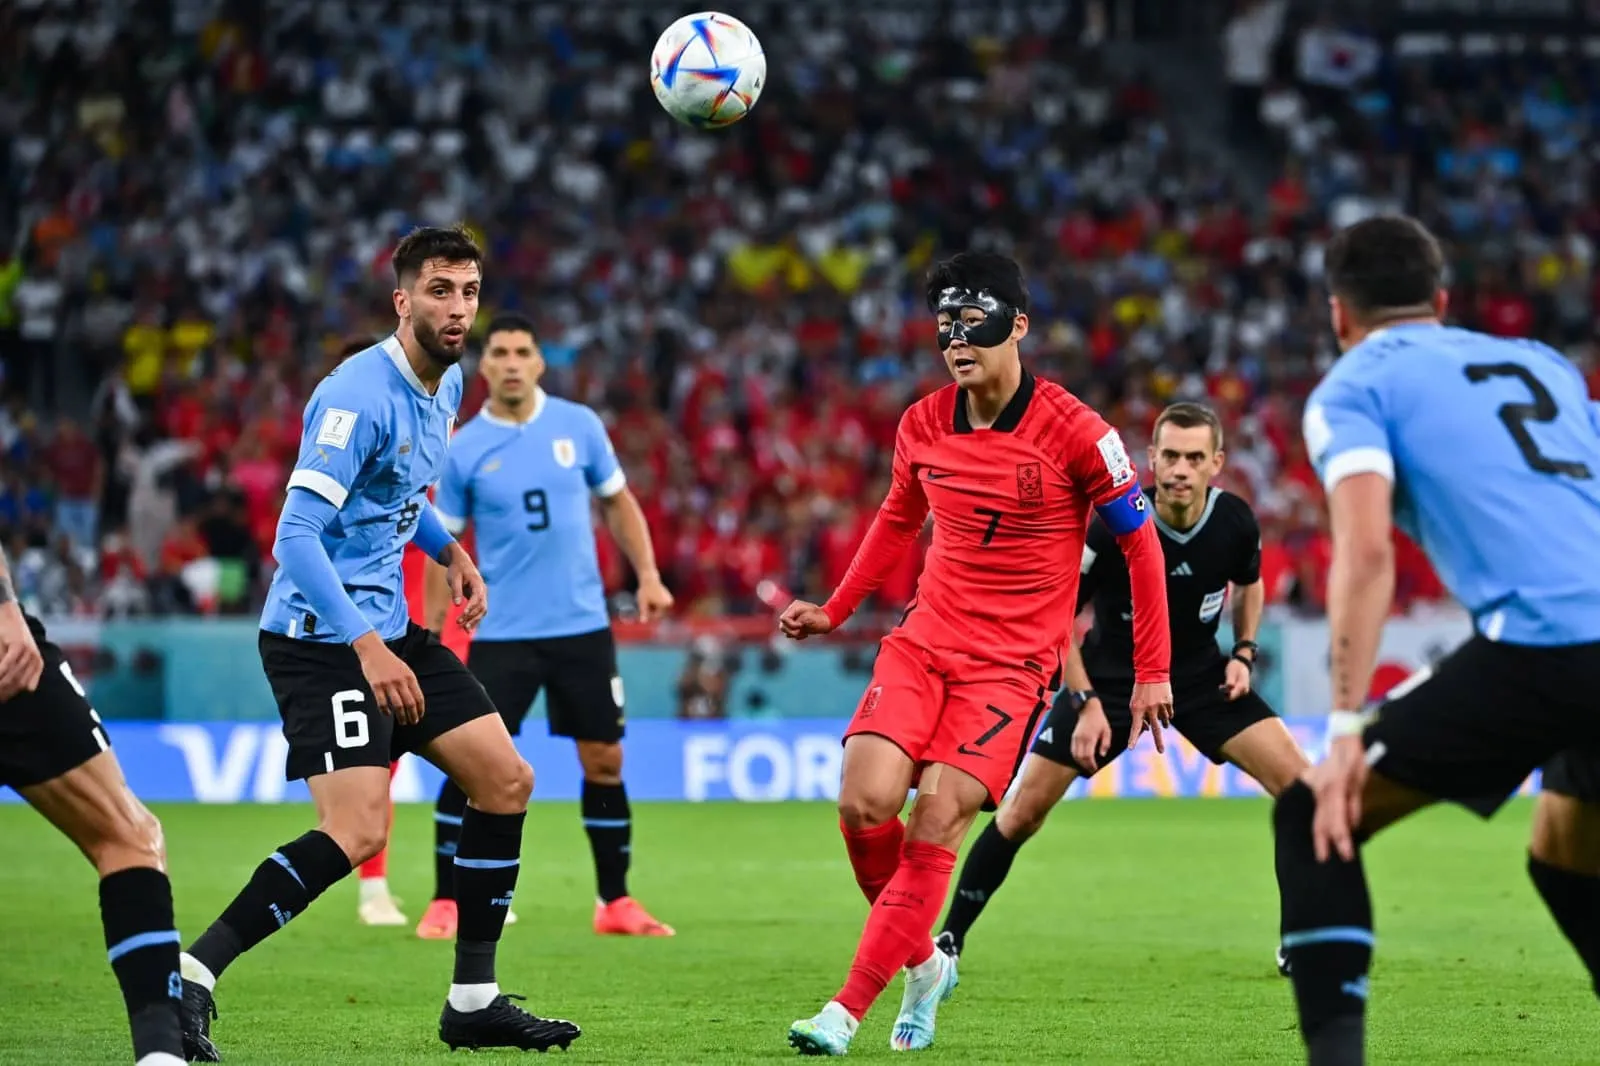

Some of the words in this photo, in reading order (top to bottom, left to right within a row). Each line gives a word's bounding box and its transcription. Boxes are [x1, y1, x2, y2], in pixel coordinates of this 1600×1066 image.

[1463, 361, 1593, 480] 2
[523, 487, 550, 533] 9
[973, 507, 1003, 546] 7
[331, 689, 370, 748] 6
[973, 703, 1014, 746] 7
